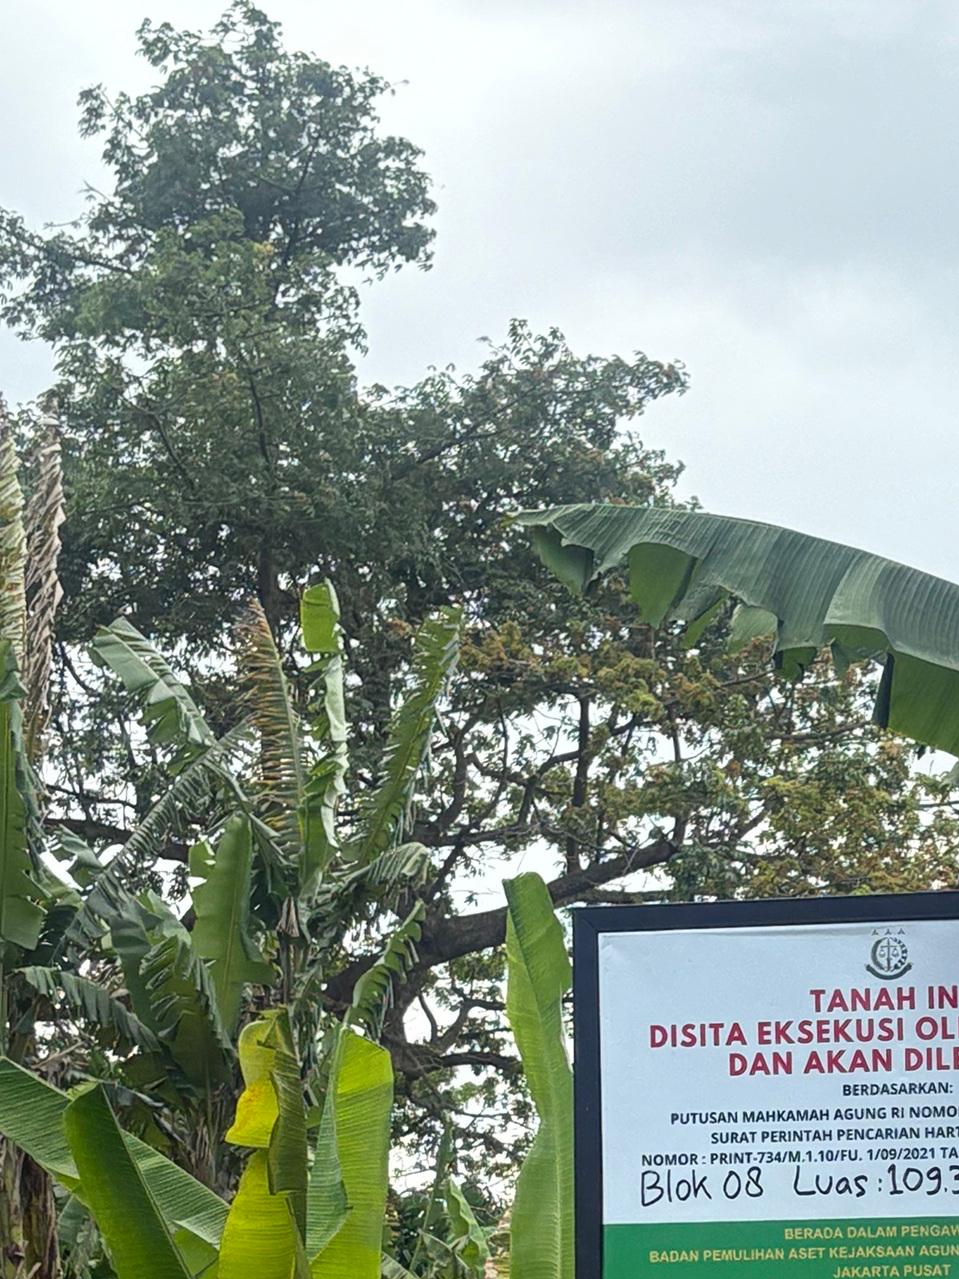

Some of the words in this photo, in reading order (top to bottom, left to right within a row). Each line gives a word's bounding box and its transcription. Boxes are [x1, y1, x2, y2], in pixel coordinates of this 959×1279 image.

[810, 986, 916, 1013] TANAH
[650, 1022, 748, 1048] DISITA
[757, 1018, 904, 1045] EKSEKUSI
[729, 1051, 793, 1077] DAN
[803, 1048, 893, 1074] AKAN
[842, 1082, 953, 1096] BERDASARKAN:
[671, 1111, 739, 1125] PUTUSAN
[742, 1109, 830, 1123] MAHKAMAH
[834, 1107, 887, 1121] AGUNG
[891, 1107, 905, 1119] RI
[711, 1132, 757, 1144] SURAT
[761, 1130, 833, 1143] PERINTAH
[837, 1127, 920, 1141] PENCARIAN
[641, 1152, 698, 1166] NOMOR
[710, 1148, 863, 1165] PRINT-734/M.1.10/FU.
[868, 1146, 936, 1161] 1/09/2021
[640, 1169, 713, 1207] Blok
[723, 1166, 764, 1200] 08
[784, 1227, 842, 1240] BERADA
[847, 1225, 896, 1238] DALAM
[649, 1250, 699, 1263] BADAN
[703, 1248, 784, 1262] PEMULIHAN
[788, 1247, 824, 1260] ASET
[829, 1244, 914, 1259] KEJAKSAAN
[833, 1264, 899, 1279] JAKARTA
[903, 1264, 951, 1278] PUSAT
